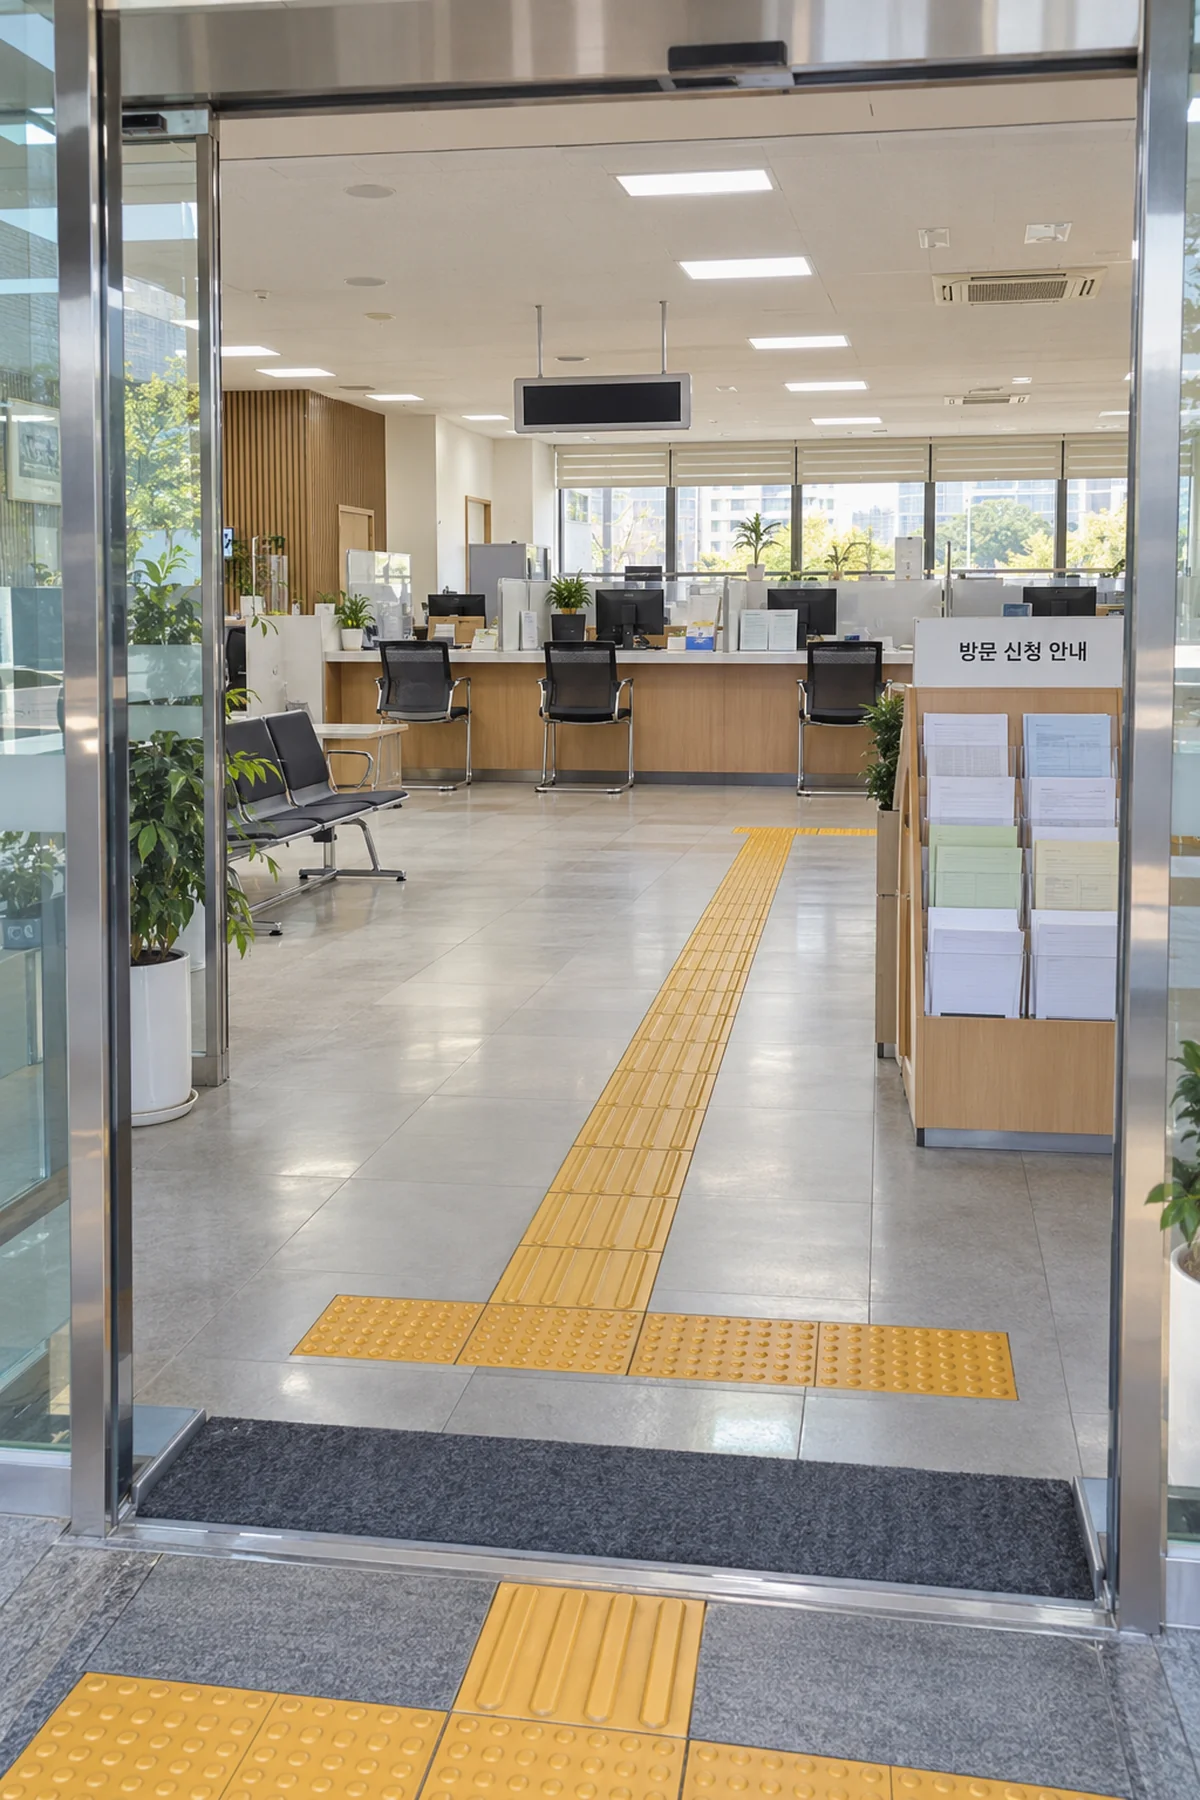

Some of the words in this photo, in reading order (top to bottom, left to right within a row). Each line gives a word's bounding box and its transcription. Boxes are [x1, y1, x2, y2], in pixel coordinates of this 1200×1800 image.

[959, 641, 998, 662] 방문
[1003, 641, 1042, 662] 신청
[1049, 641, 1087, 662] 안내
